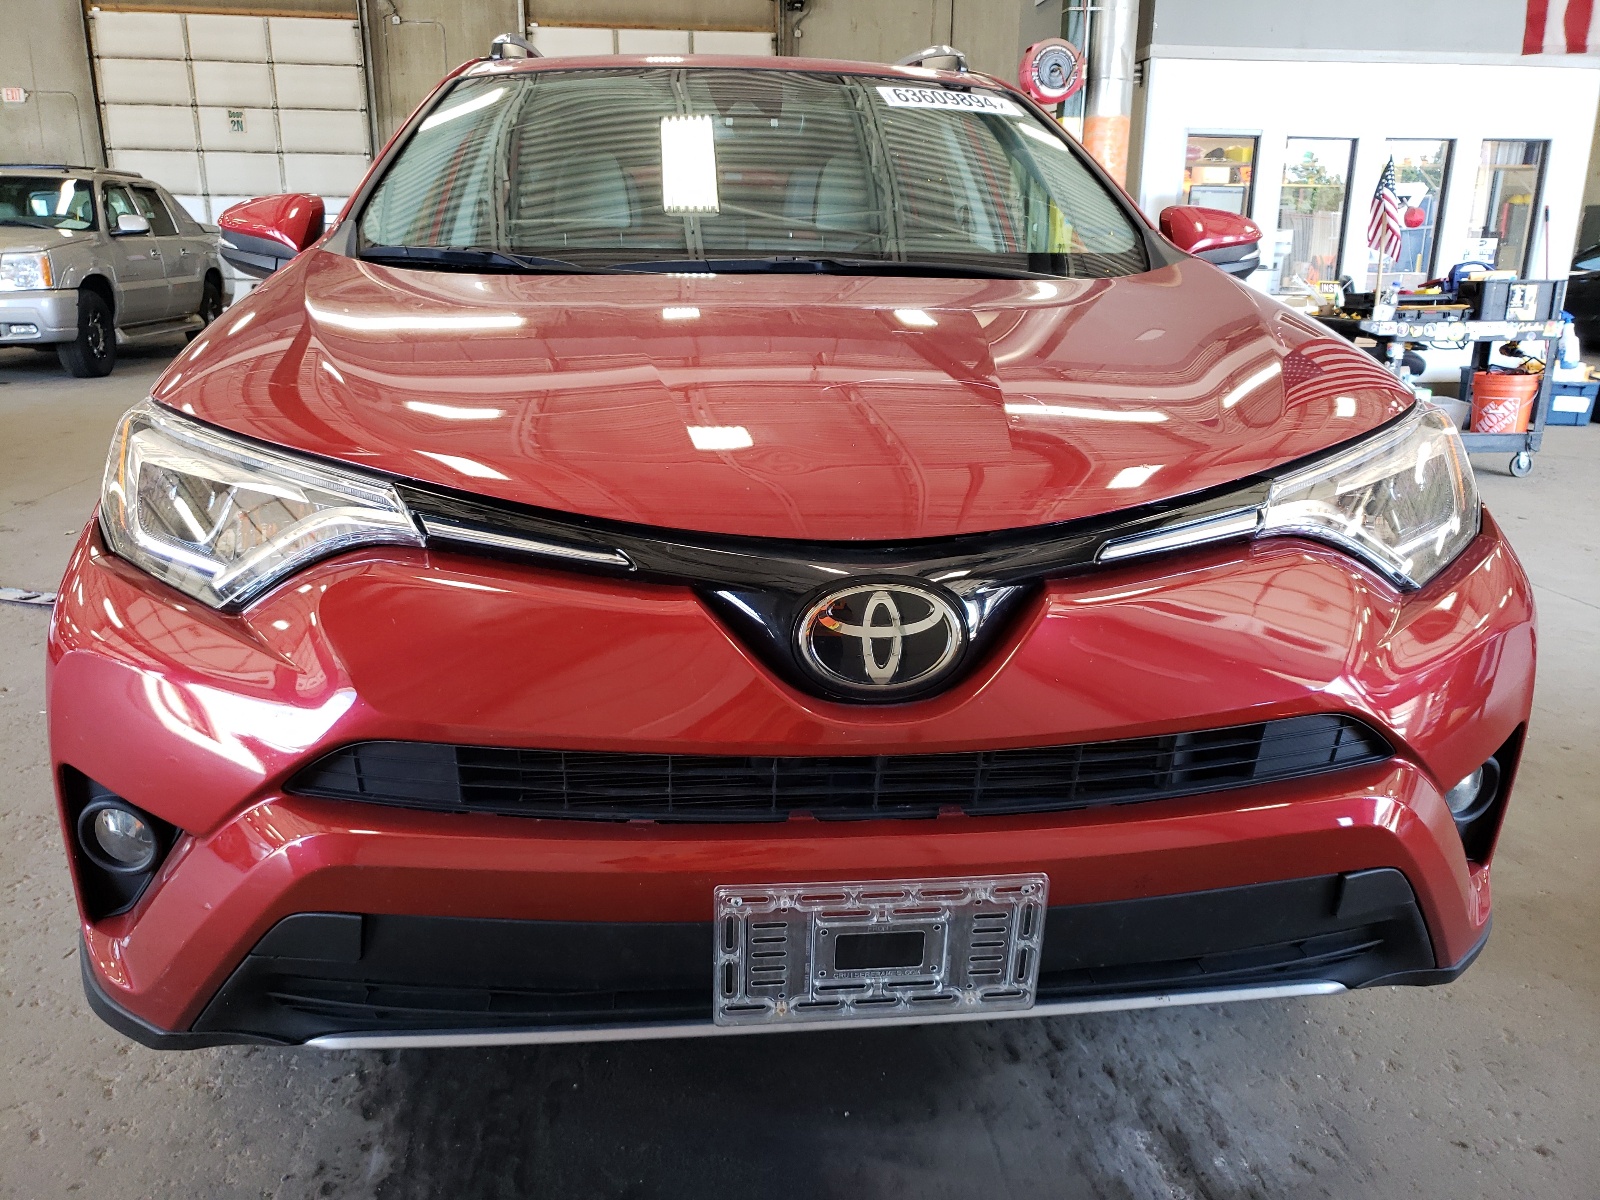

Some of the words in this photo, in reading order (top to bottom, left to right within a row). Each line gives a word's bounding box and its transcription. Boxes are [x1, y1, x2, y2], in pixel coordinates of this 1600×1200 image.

[6, 88, 21, 101] EXIT
[892, 88, 998, 110] 63609894
[230, 119, 244, 132] 2N
[1476, 399, 1519, 433] HOME
[1481, 400, 1499, 417] THE
[1488, 411, 1518, 433] DEPOT
[867, 924, 893, 933] FRONT
